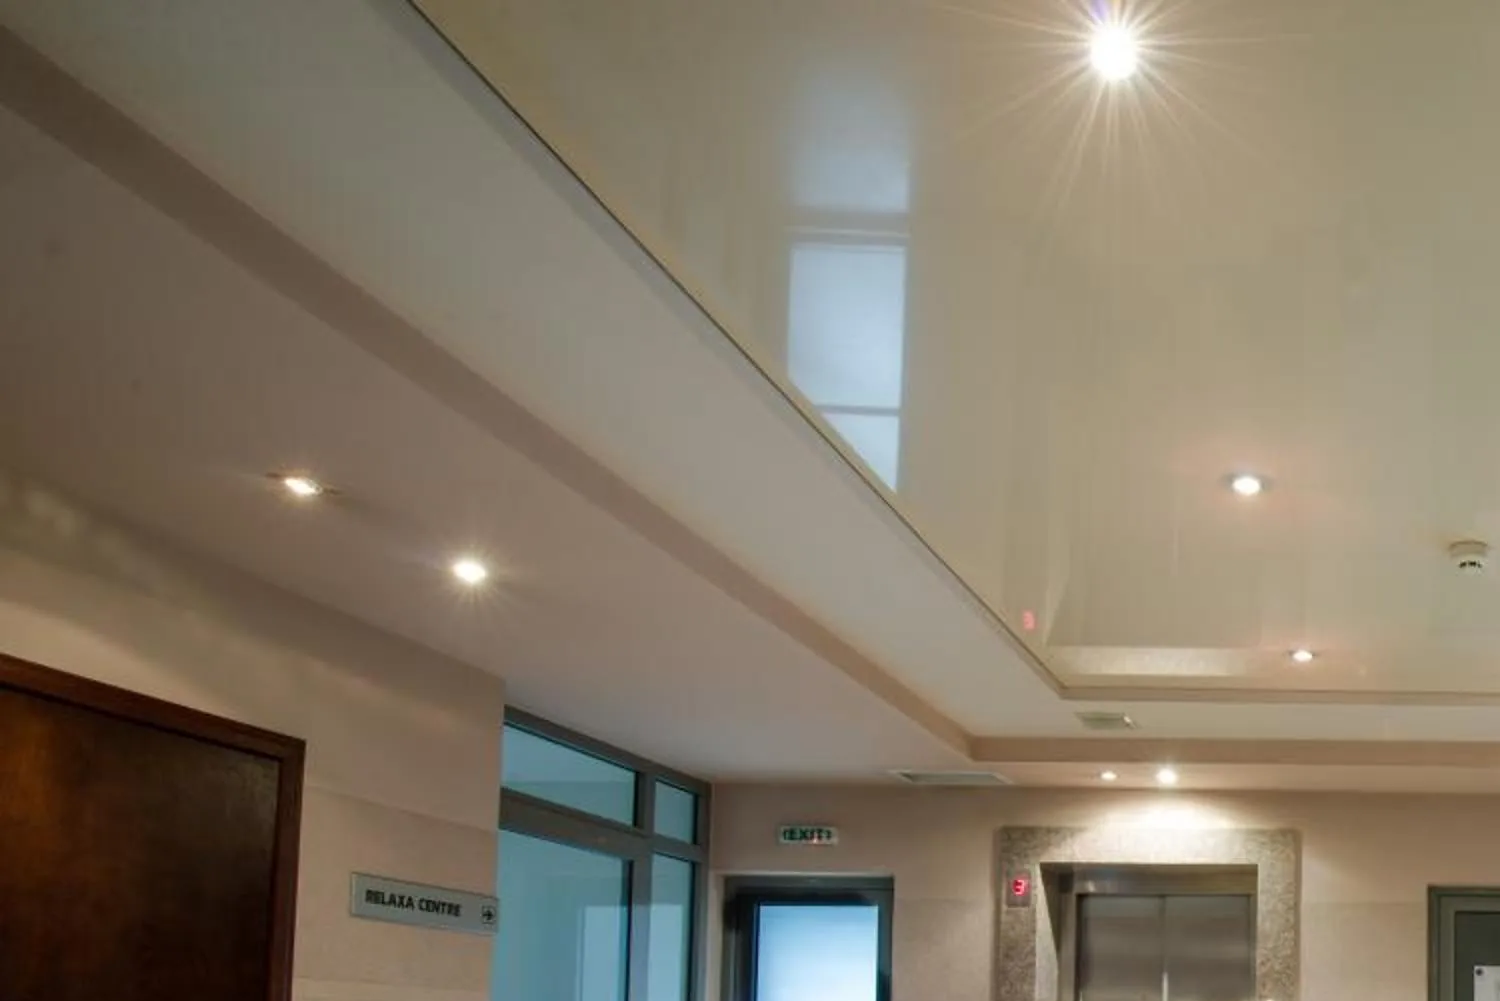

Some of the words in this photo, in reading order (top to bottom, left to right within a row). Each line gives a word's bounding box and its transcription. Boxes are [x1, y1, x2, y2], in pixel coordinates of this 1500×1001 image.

[1014, 879, 1025, 895] 3
[365, 889, 415, 909] RELAXA
[418, 897, 461, 917] CENTRE
